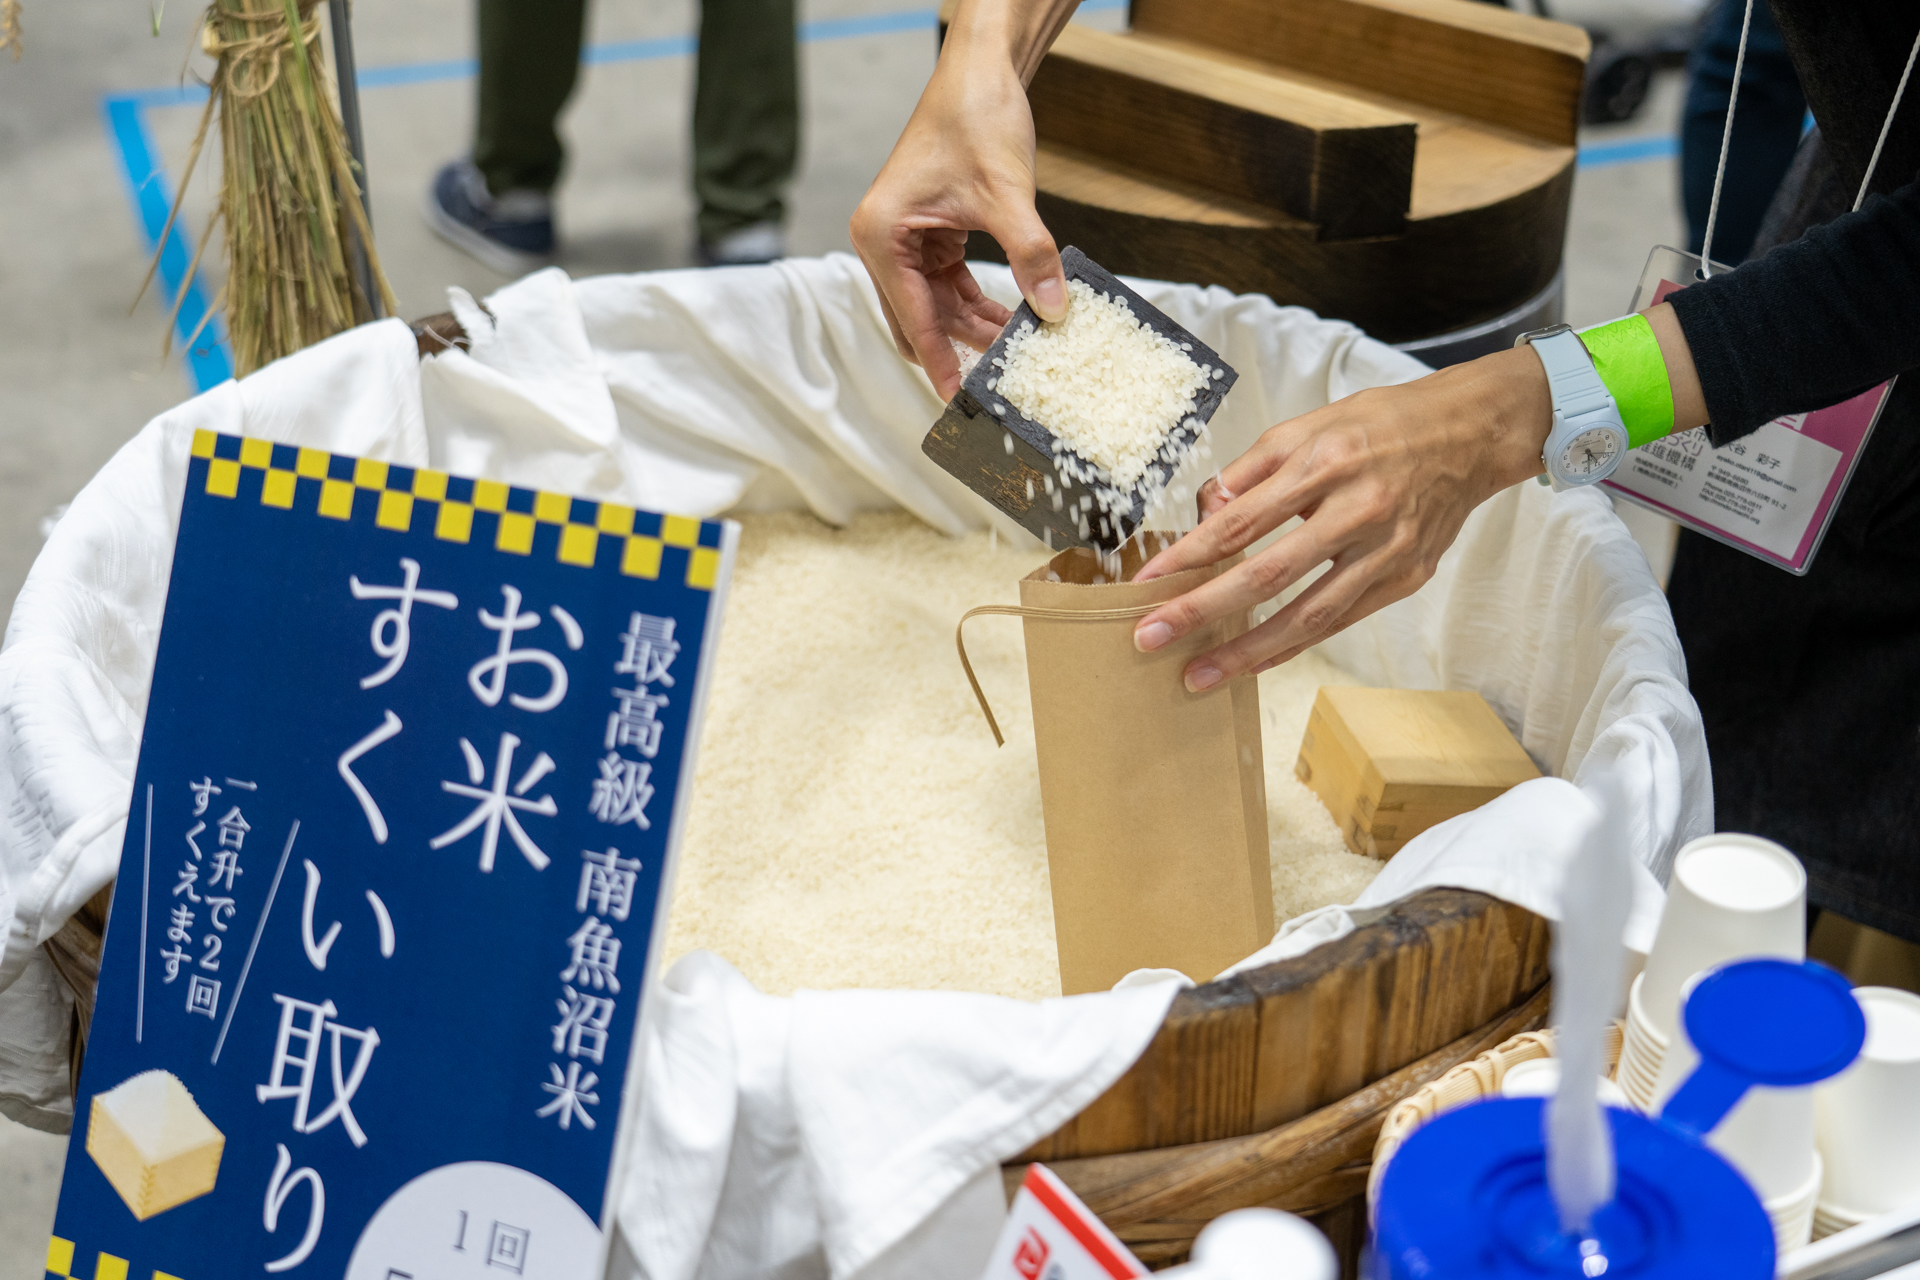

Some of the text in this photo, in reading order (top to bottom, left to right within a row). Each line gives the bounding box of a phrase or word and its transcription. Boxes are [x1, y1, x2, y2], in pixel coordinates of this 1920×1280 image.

[429, 583, 585, 874] お米
[159, 775, 223, 984] すくえます
[185, 776, 258, 1021] 一合升で2回
[255, 556, 460, 1274] すくい取り
[534, 610, 681, 1131] 最高級 南魚沼米
[452, 1209, 532, 1277] 1回
